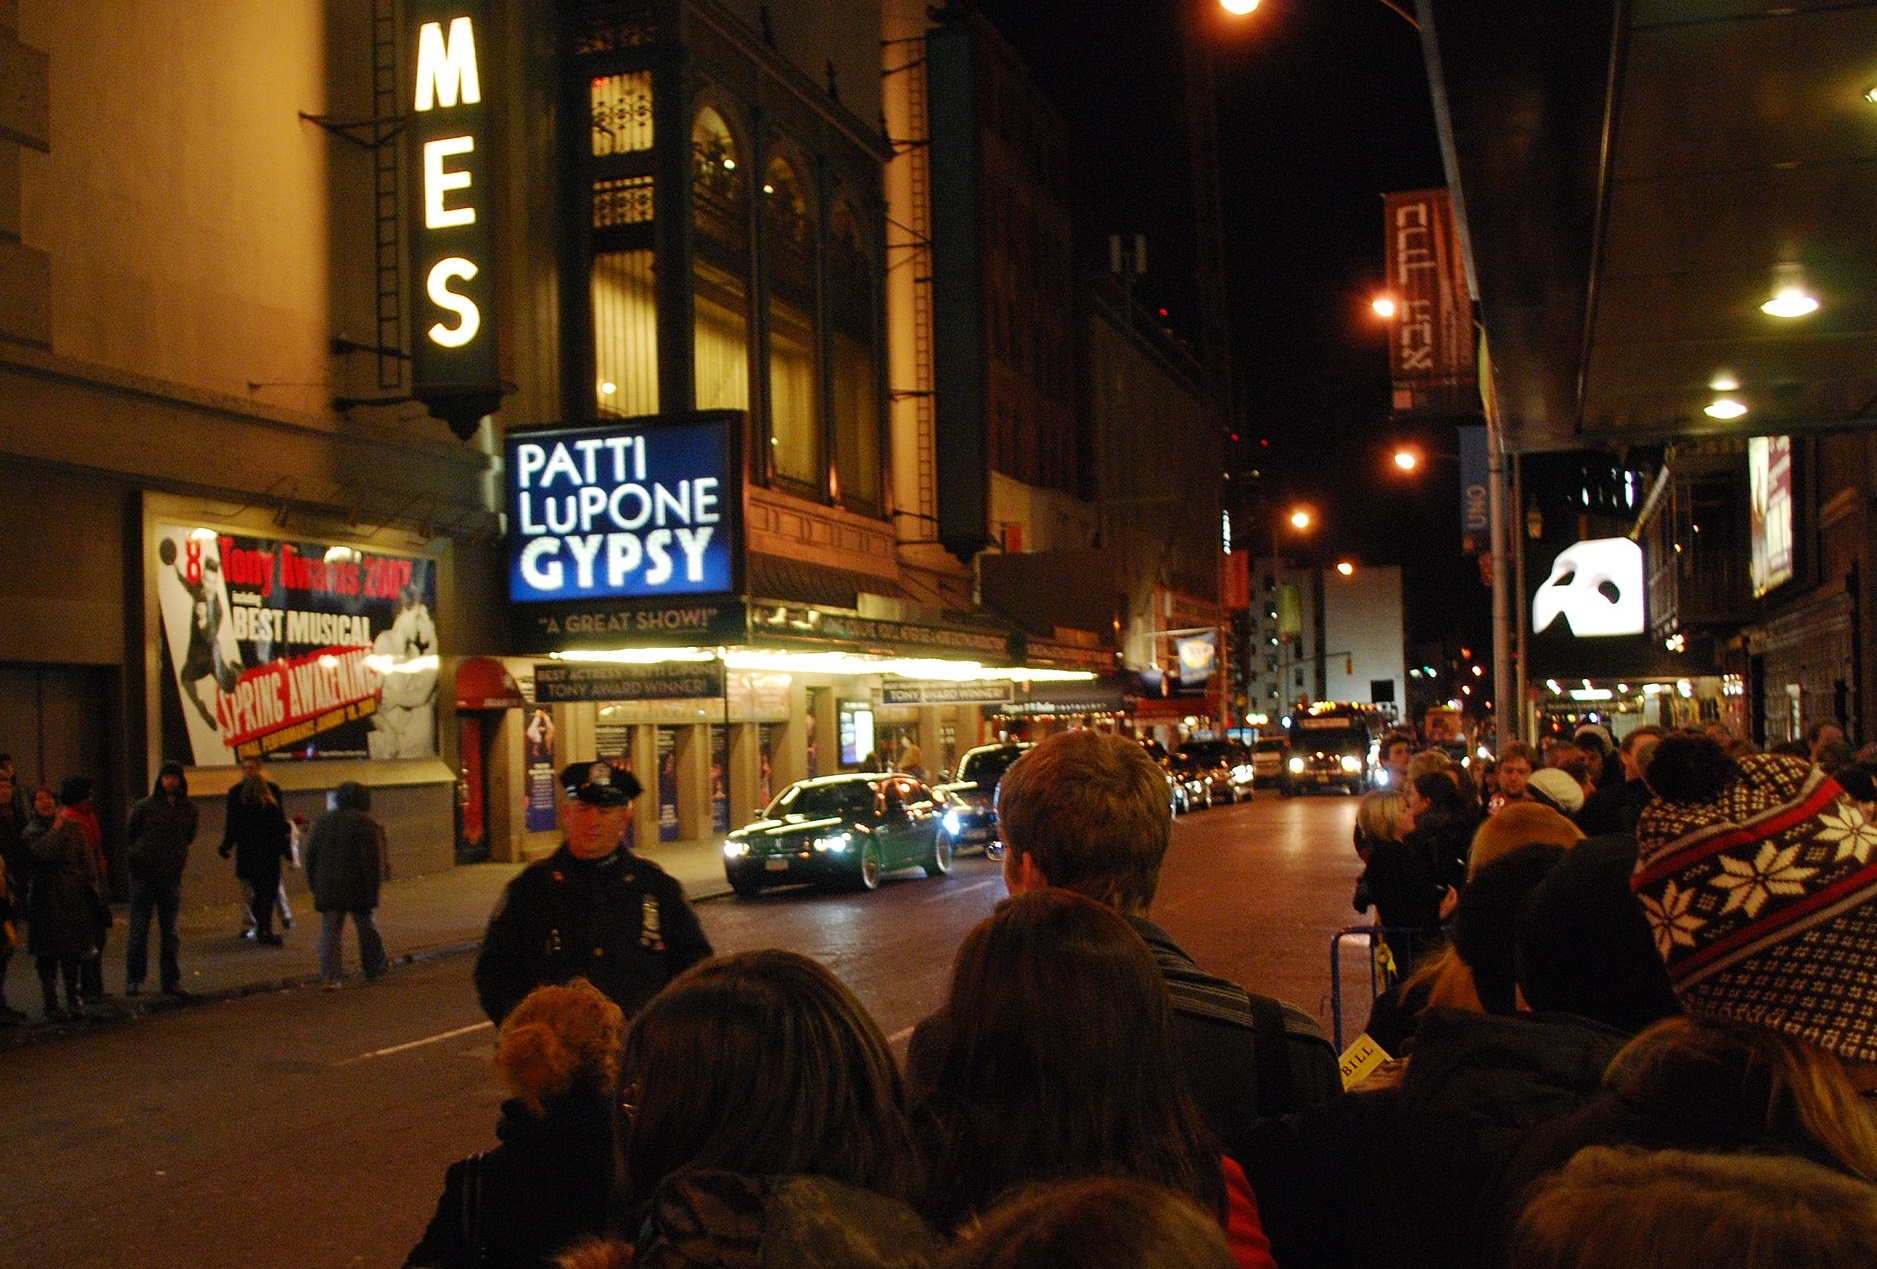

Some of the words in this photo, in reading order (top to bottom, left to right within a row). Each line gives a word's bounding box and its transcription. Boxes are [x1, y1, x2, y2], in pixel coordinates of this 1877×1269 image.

[517, 435, 646, 488] PATTI
[185, 533, 202, 585] 8
[217, 535, 276, 597] Tony
[280, 544, 361, 596] Awards
[520, 526, 715, 591] GYPSY
[233, 606, 285, 642] BEST
[286, 610, 373, 646] MUSICAL
[565, 611, 631, 633] GREAT
[219, 671, 285, 736] SPRING
[547, 683, 588, 698] TONY
[591, 681, 642, 696] AWARD
[890, 689, 919, 702] TONY
[1341, 1046, 1374, 1077] BILL
